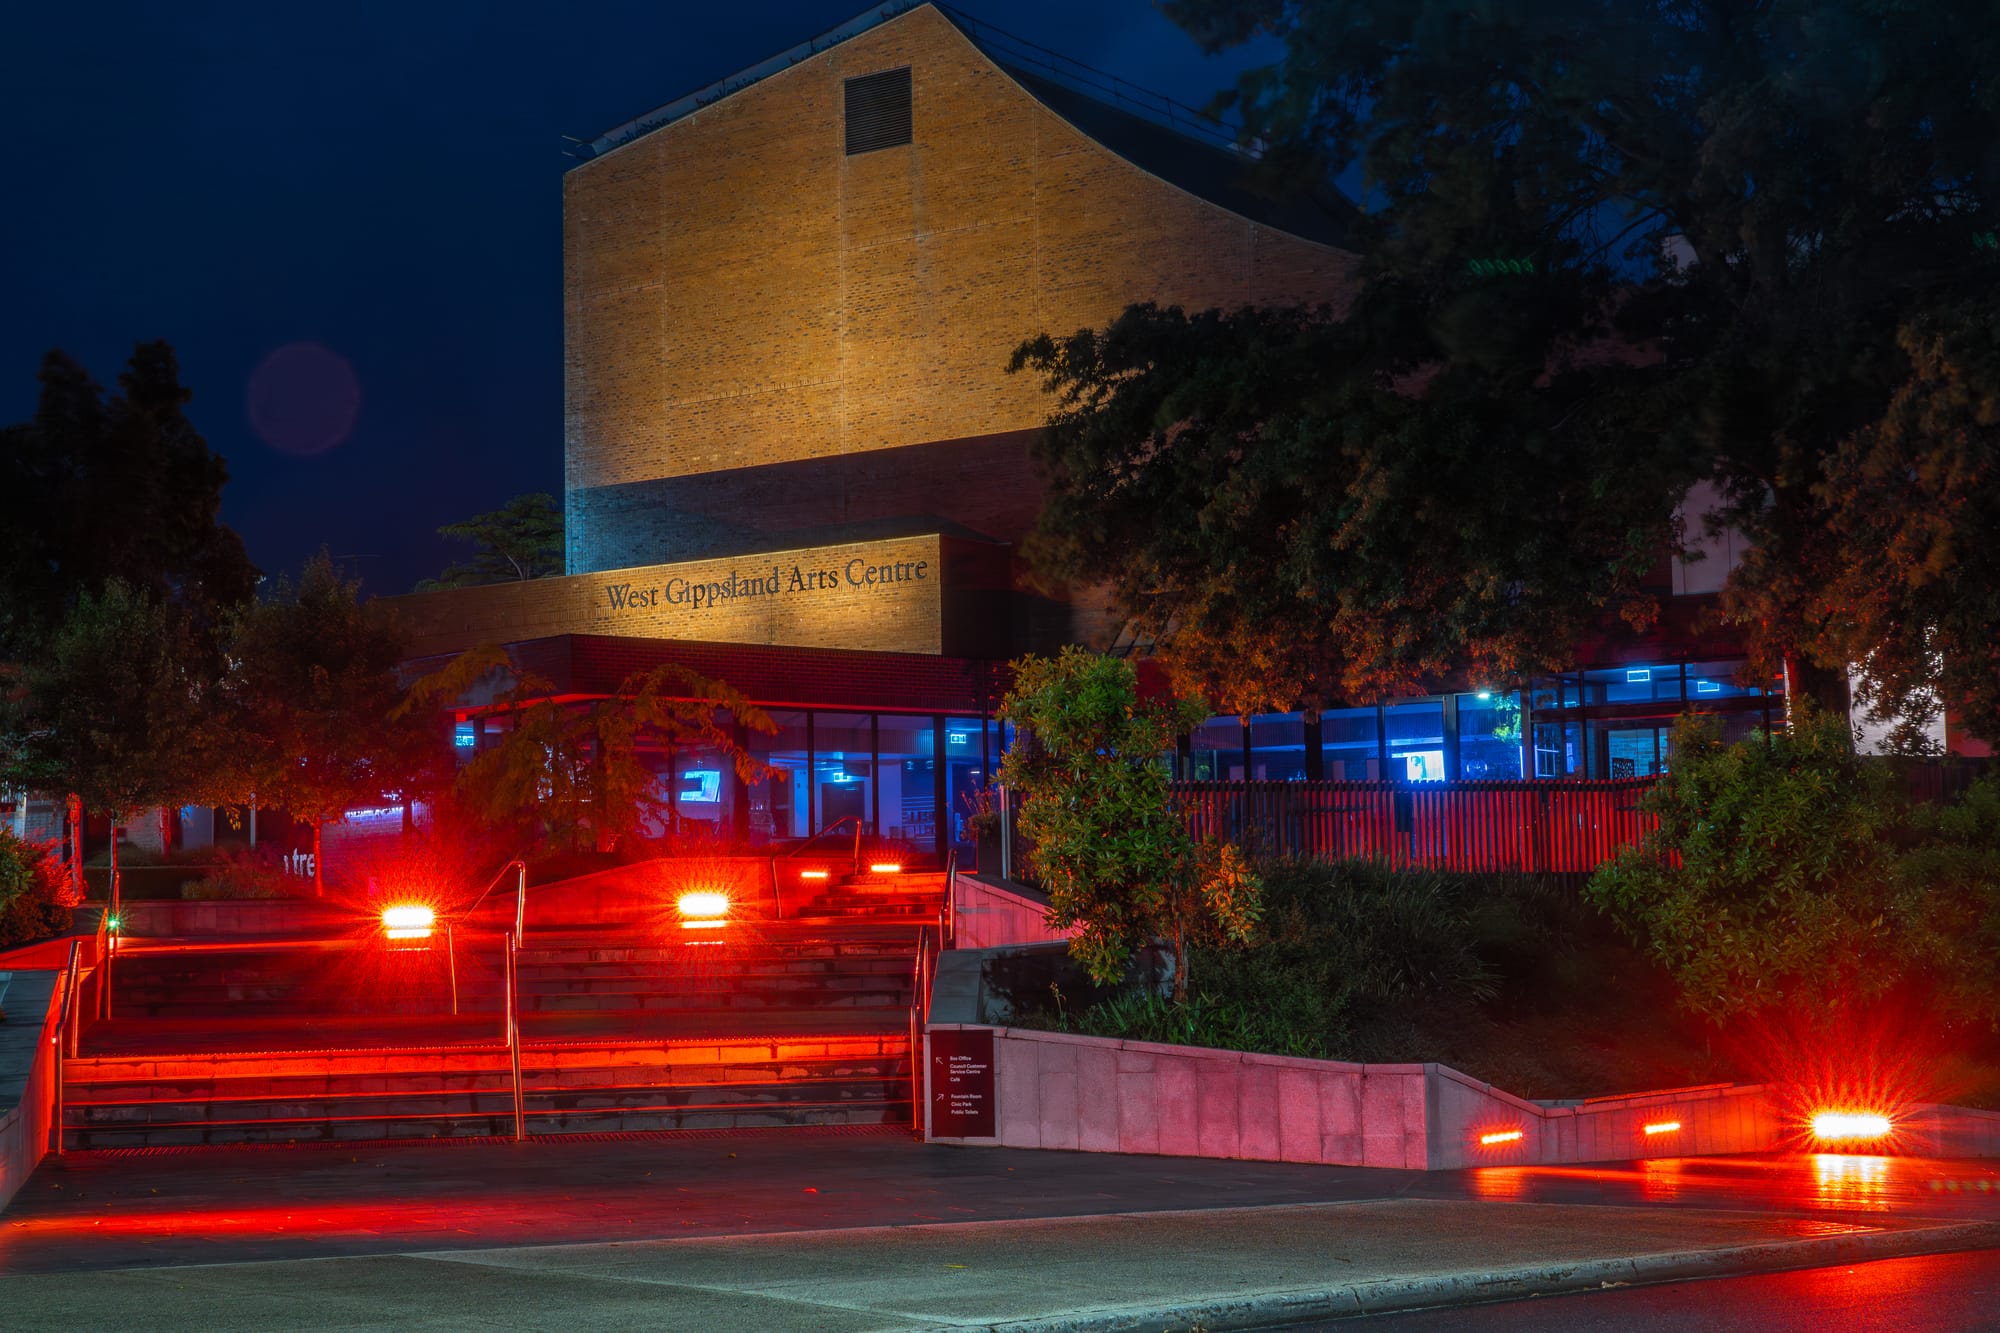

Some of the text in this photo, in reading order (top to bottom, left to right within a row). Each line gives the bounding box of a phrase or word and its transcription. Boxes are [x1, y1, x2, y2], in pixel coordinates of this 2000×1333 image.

[605, 558, 928, 610] West Gippsland Arts Centre
